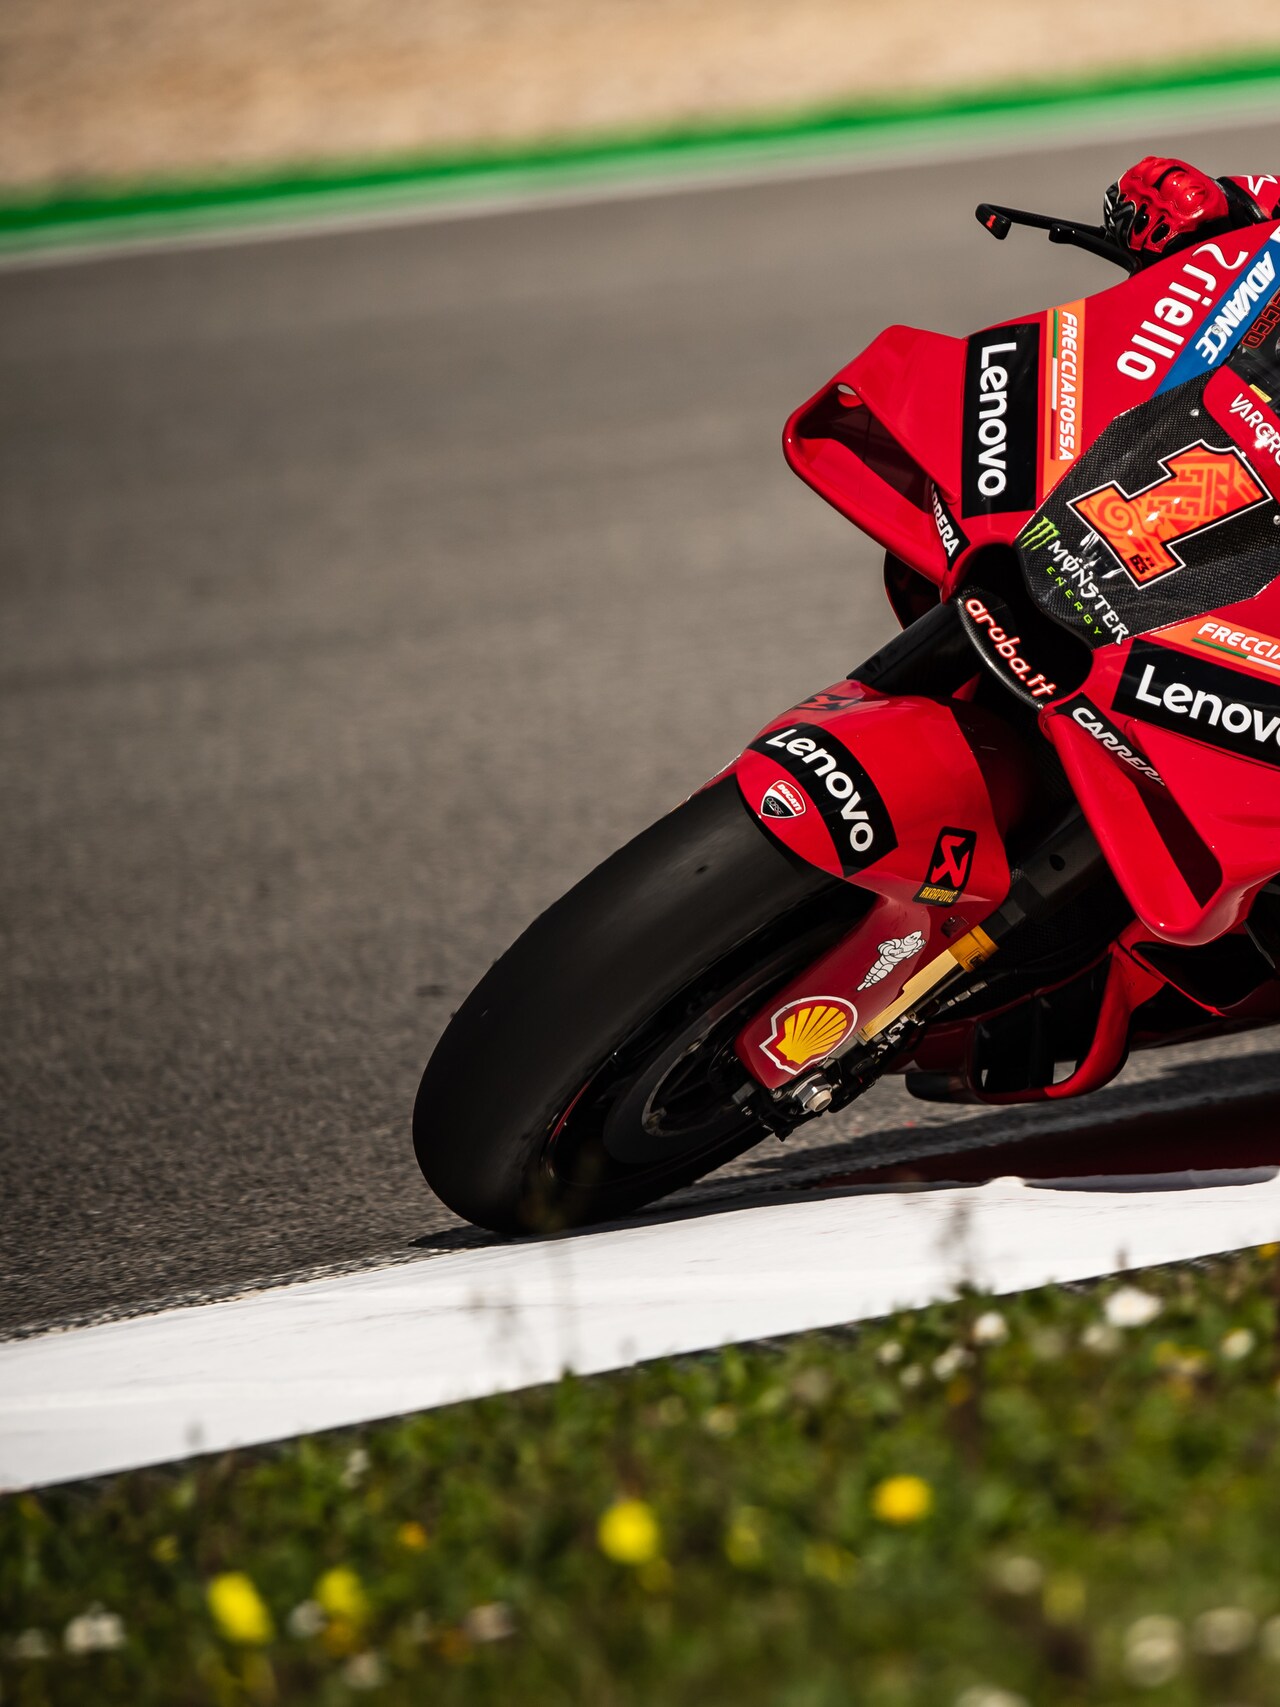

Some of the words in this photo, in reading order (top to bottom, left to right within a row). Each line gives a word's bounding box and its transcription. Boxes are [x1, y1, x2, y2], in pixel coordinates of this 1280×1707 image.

[1116, 263, 1217, 381] riello
[1195, 250, 1276, 365] ADVANCE
[978, 342, 1018, 497] Lenovo
[1059, 311, 1078, 461] FRECCIAROSSA
[1066, 438, 1273, 590] 1
[965, 598, 1057, 697] aruba.it
[1046, 566, 1103, 636] ENERGY
[765, 728, 874, 852] Lenovo
[777, 783, 802, 812] DUCATI
